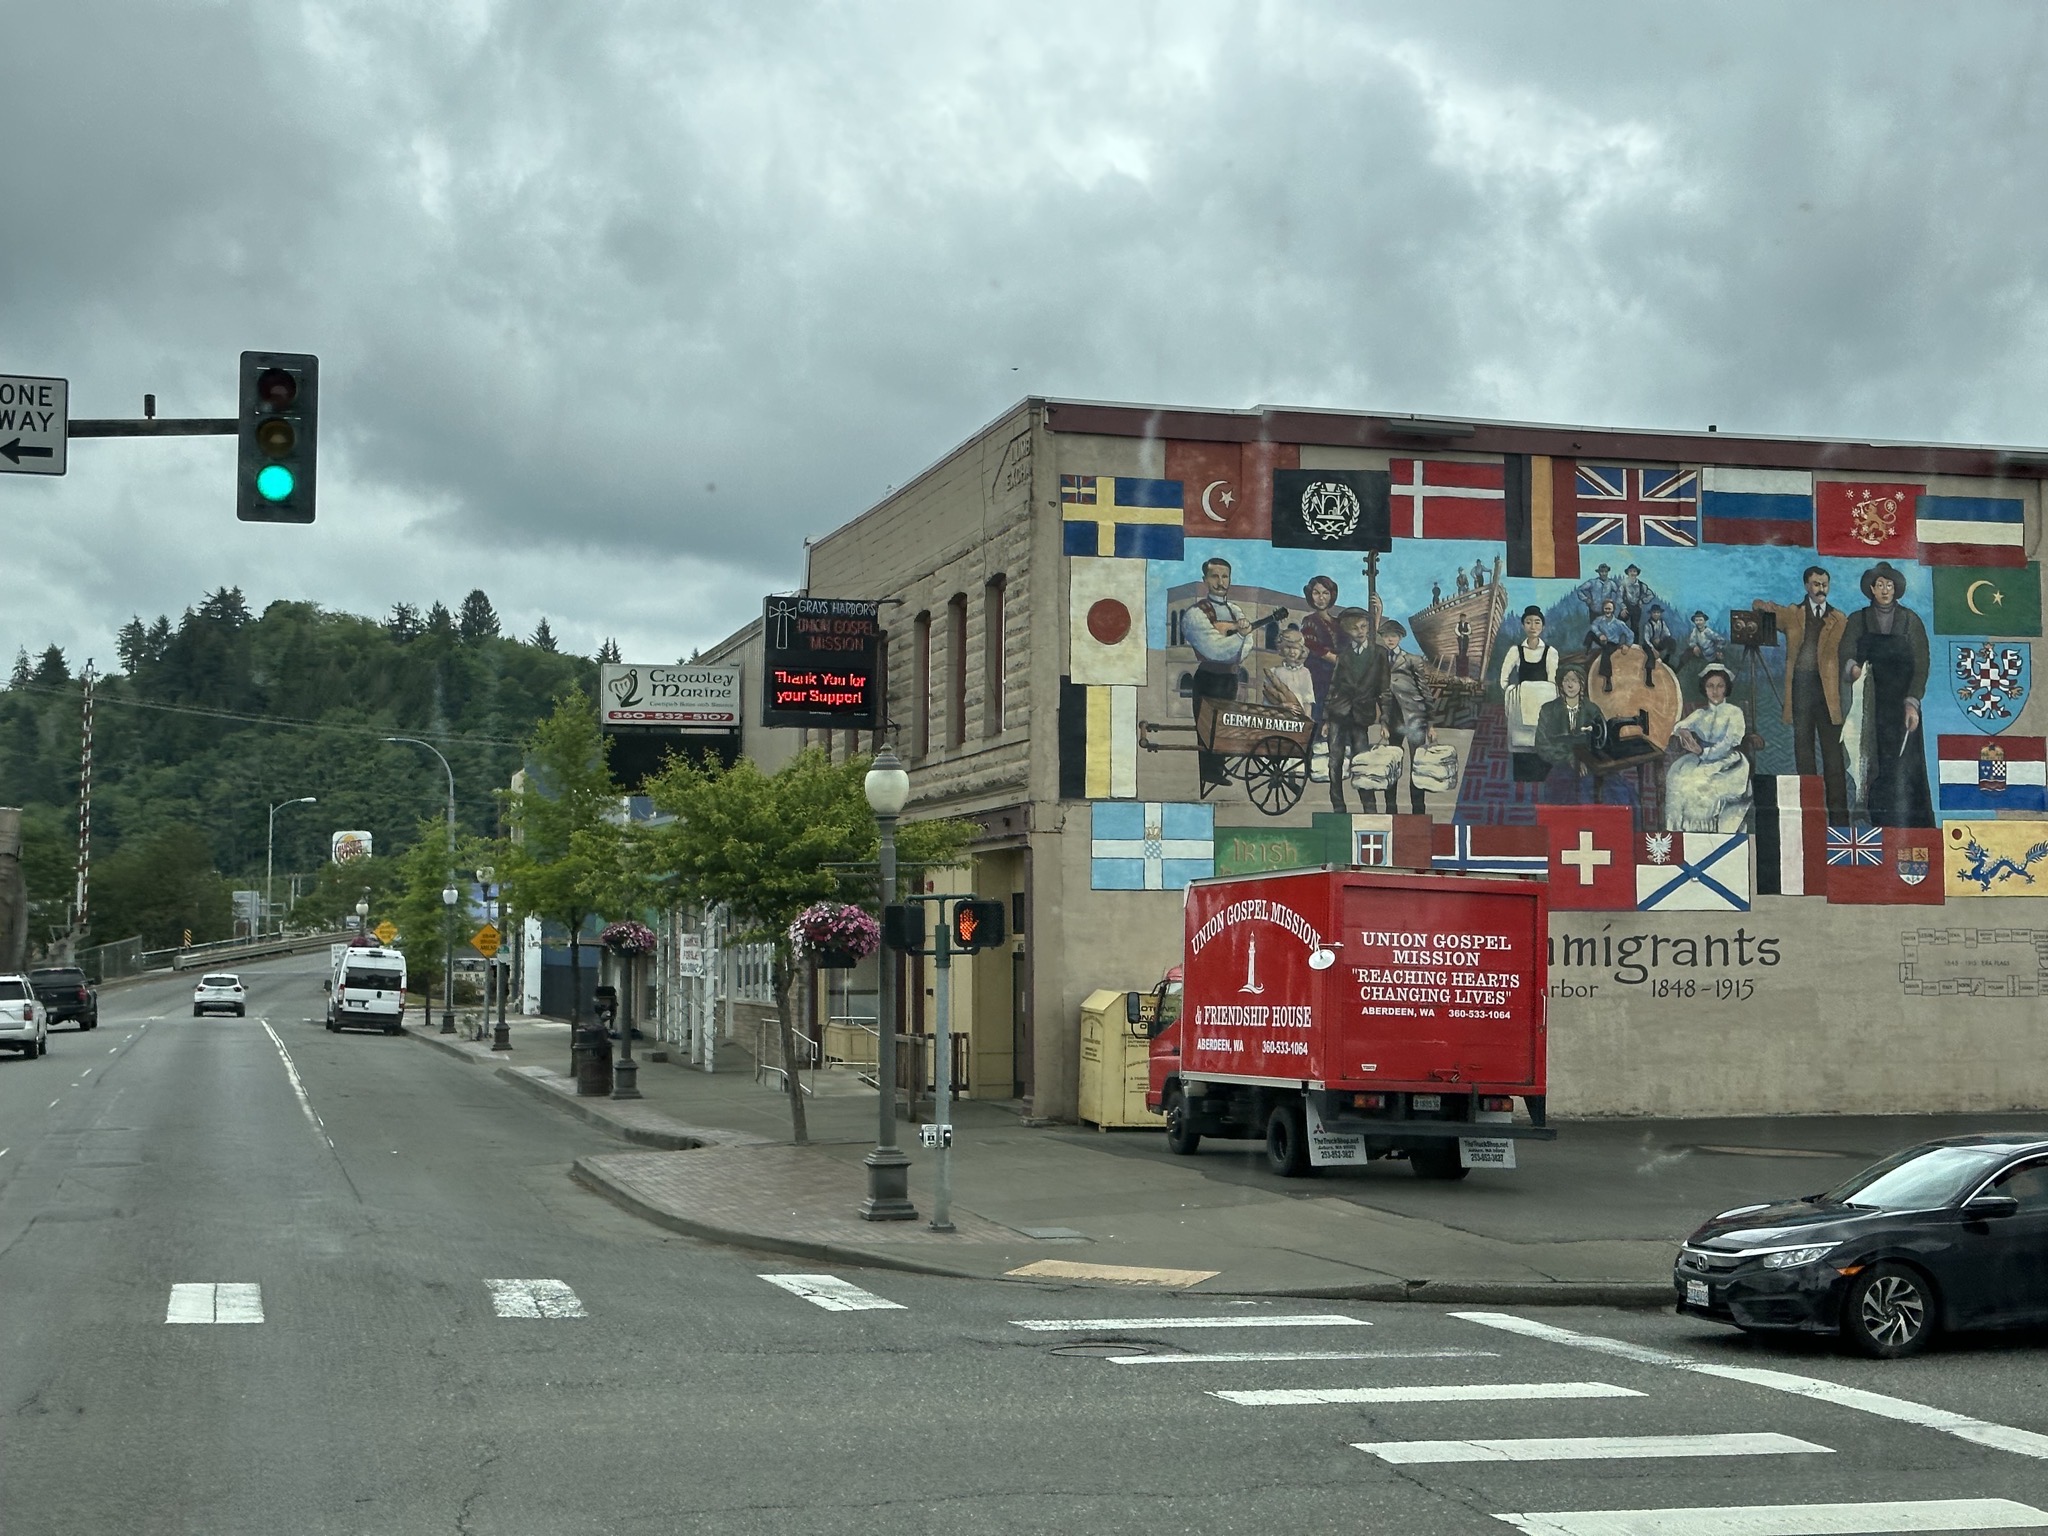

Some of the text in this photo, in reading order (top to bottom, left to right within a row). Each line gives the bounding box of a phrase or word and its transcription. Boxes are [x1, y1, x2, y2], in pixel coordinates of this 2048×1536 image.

[0, 383, 53, 407] ONE
[0, 409, 55, 432] WAY
[798, 600, 828, 614] GRAYS
[834, 620, 877, 636] GOSPEL
[811, 636, 864, 651] MISSION
[649, 668, 734, 687] Crowley
[775, 671, 866, 687] Thank You for
[651, 683, 732, 698] Marine
[777, 690, 862, 705] your Support
[612, 711, 730, 721] 360-532-5107
[1223, 712, 1305, 733] GERMAN BAKERY
[1191, 899, 1321, 955] UNION GOSPEL MISSION
[1361, 931, 1512, 950] UNION GOSPEL
[1392, 950, 1480, 966] MISSION
[1548, 923, 1781, 984] migrants
[1352, 968, 1520, 988] "REACHING HEARTS
[1360, 986, 1512, 1005] CHANGING LIVES"
[1548, 978, 1599, 998] rbor
[1194, 1005, 1312, 1028] & FRIENDSHIP HOUSE
[1361, 1006, 1511, 1020] ABERDEEN, WA 360-533-1064
[1197, 1038, 1309, 1056] ABERDEEN, WA 360-533-1064
